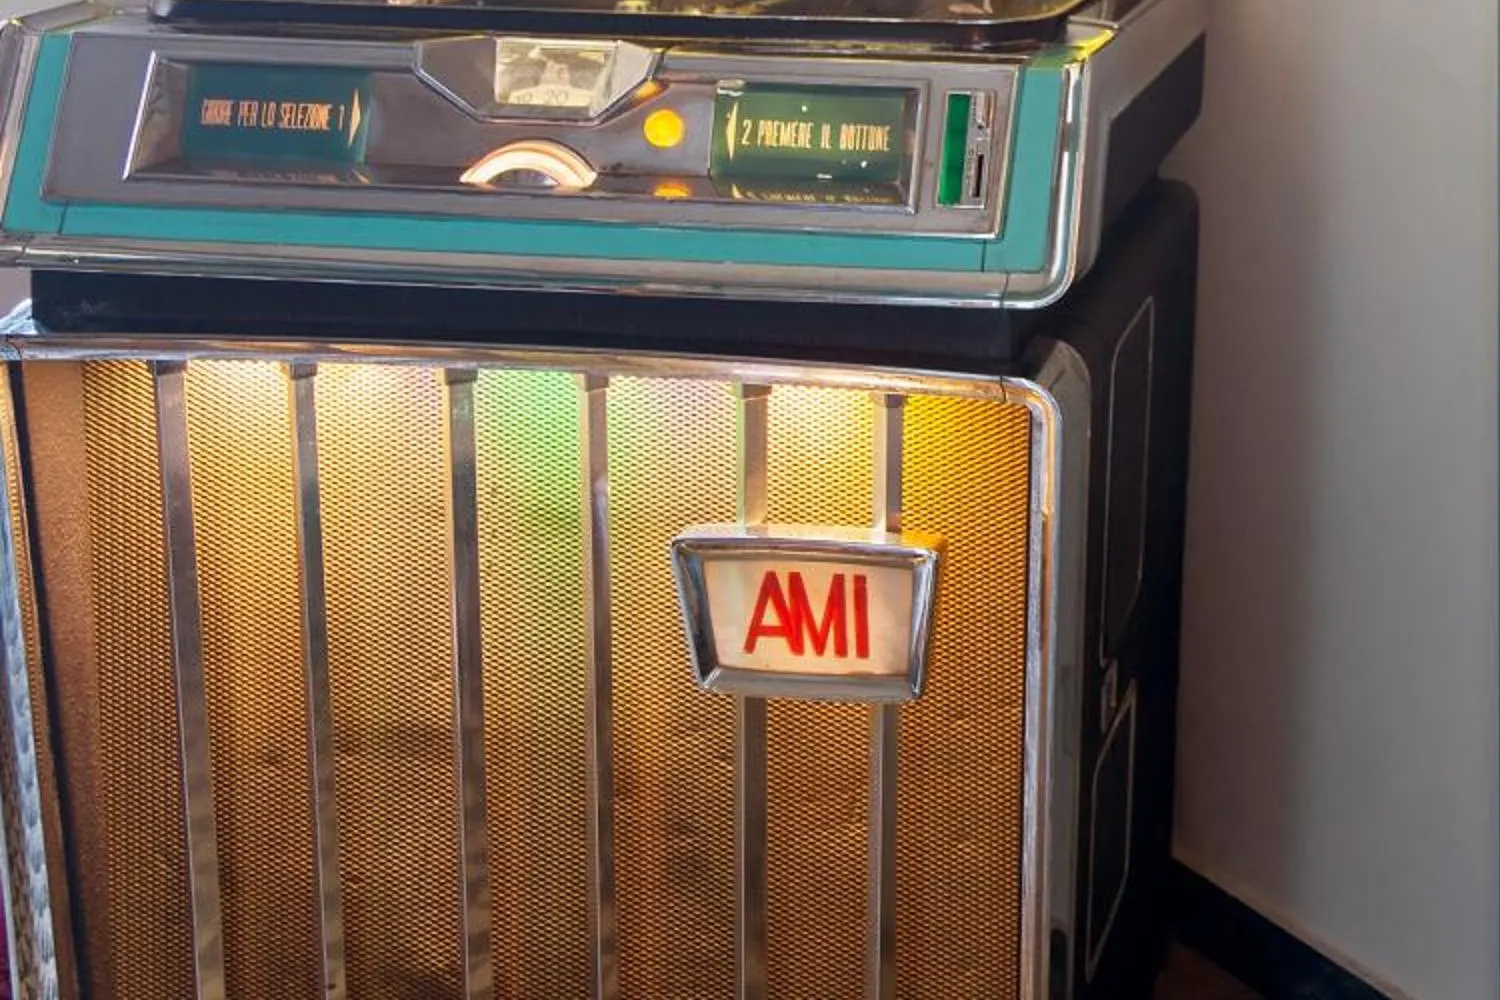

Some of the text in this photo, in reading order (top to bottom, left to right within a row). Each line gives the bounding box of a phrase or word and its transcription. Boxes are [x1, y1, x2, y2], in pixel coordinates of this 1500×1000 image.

[238, 99, 259, 128] PER
[741, 119, 752, 145] 2
[758, 119, 815, 149] PREMERE
[820, 122, 832, 149] IL
[743, 570, 870, 659] AMI
